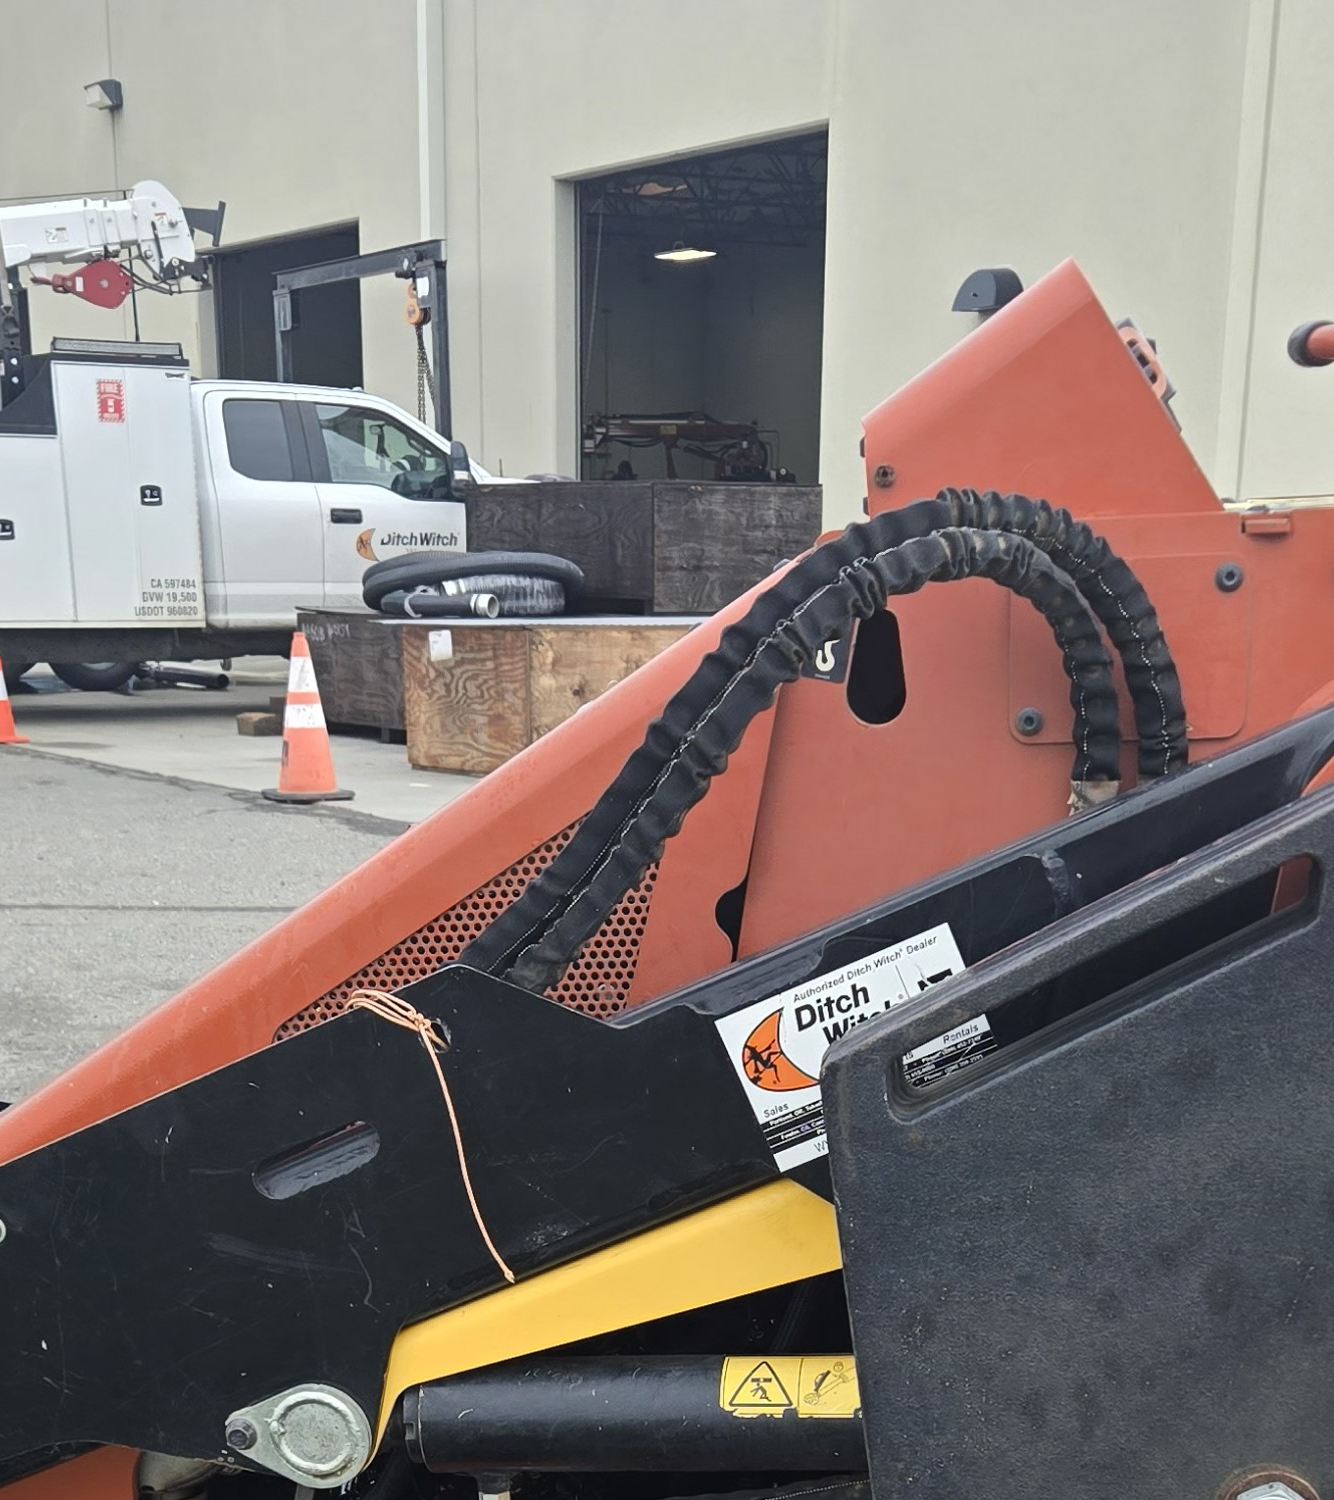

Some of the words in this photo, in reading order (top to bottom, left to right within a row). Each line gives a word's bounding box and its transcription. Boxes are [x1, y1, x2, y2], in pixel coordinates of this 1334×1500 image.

[419, 531, 458, 546] Witch
[150, 578, 163, 589] CA
[142, 591, 164, 602] GVW
[134, 605, 164, 617] USDOT
[793, 974, 845, 1003] Authorized
[847, 963, 872, 981] Ditch
[906, 935, 938, 955] Dealer
[794, 982, 870, 1032] Ditch
[942, 1023, 979, 1044] Rentals
[763, 1103, 790, 1118] Sales
